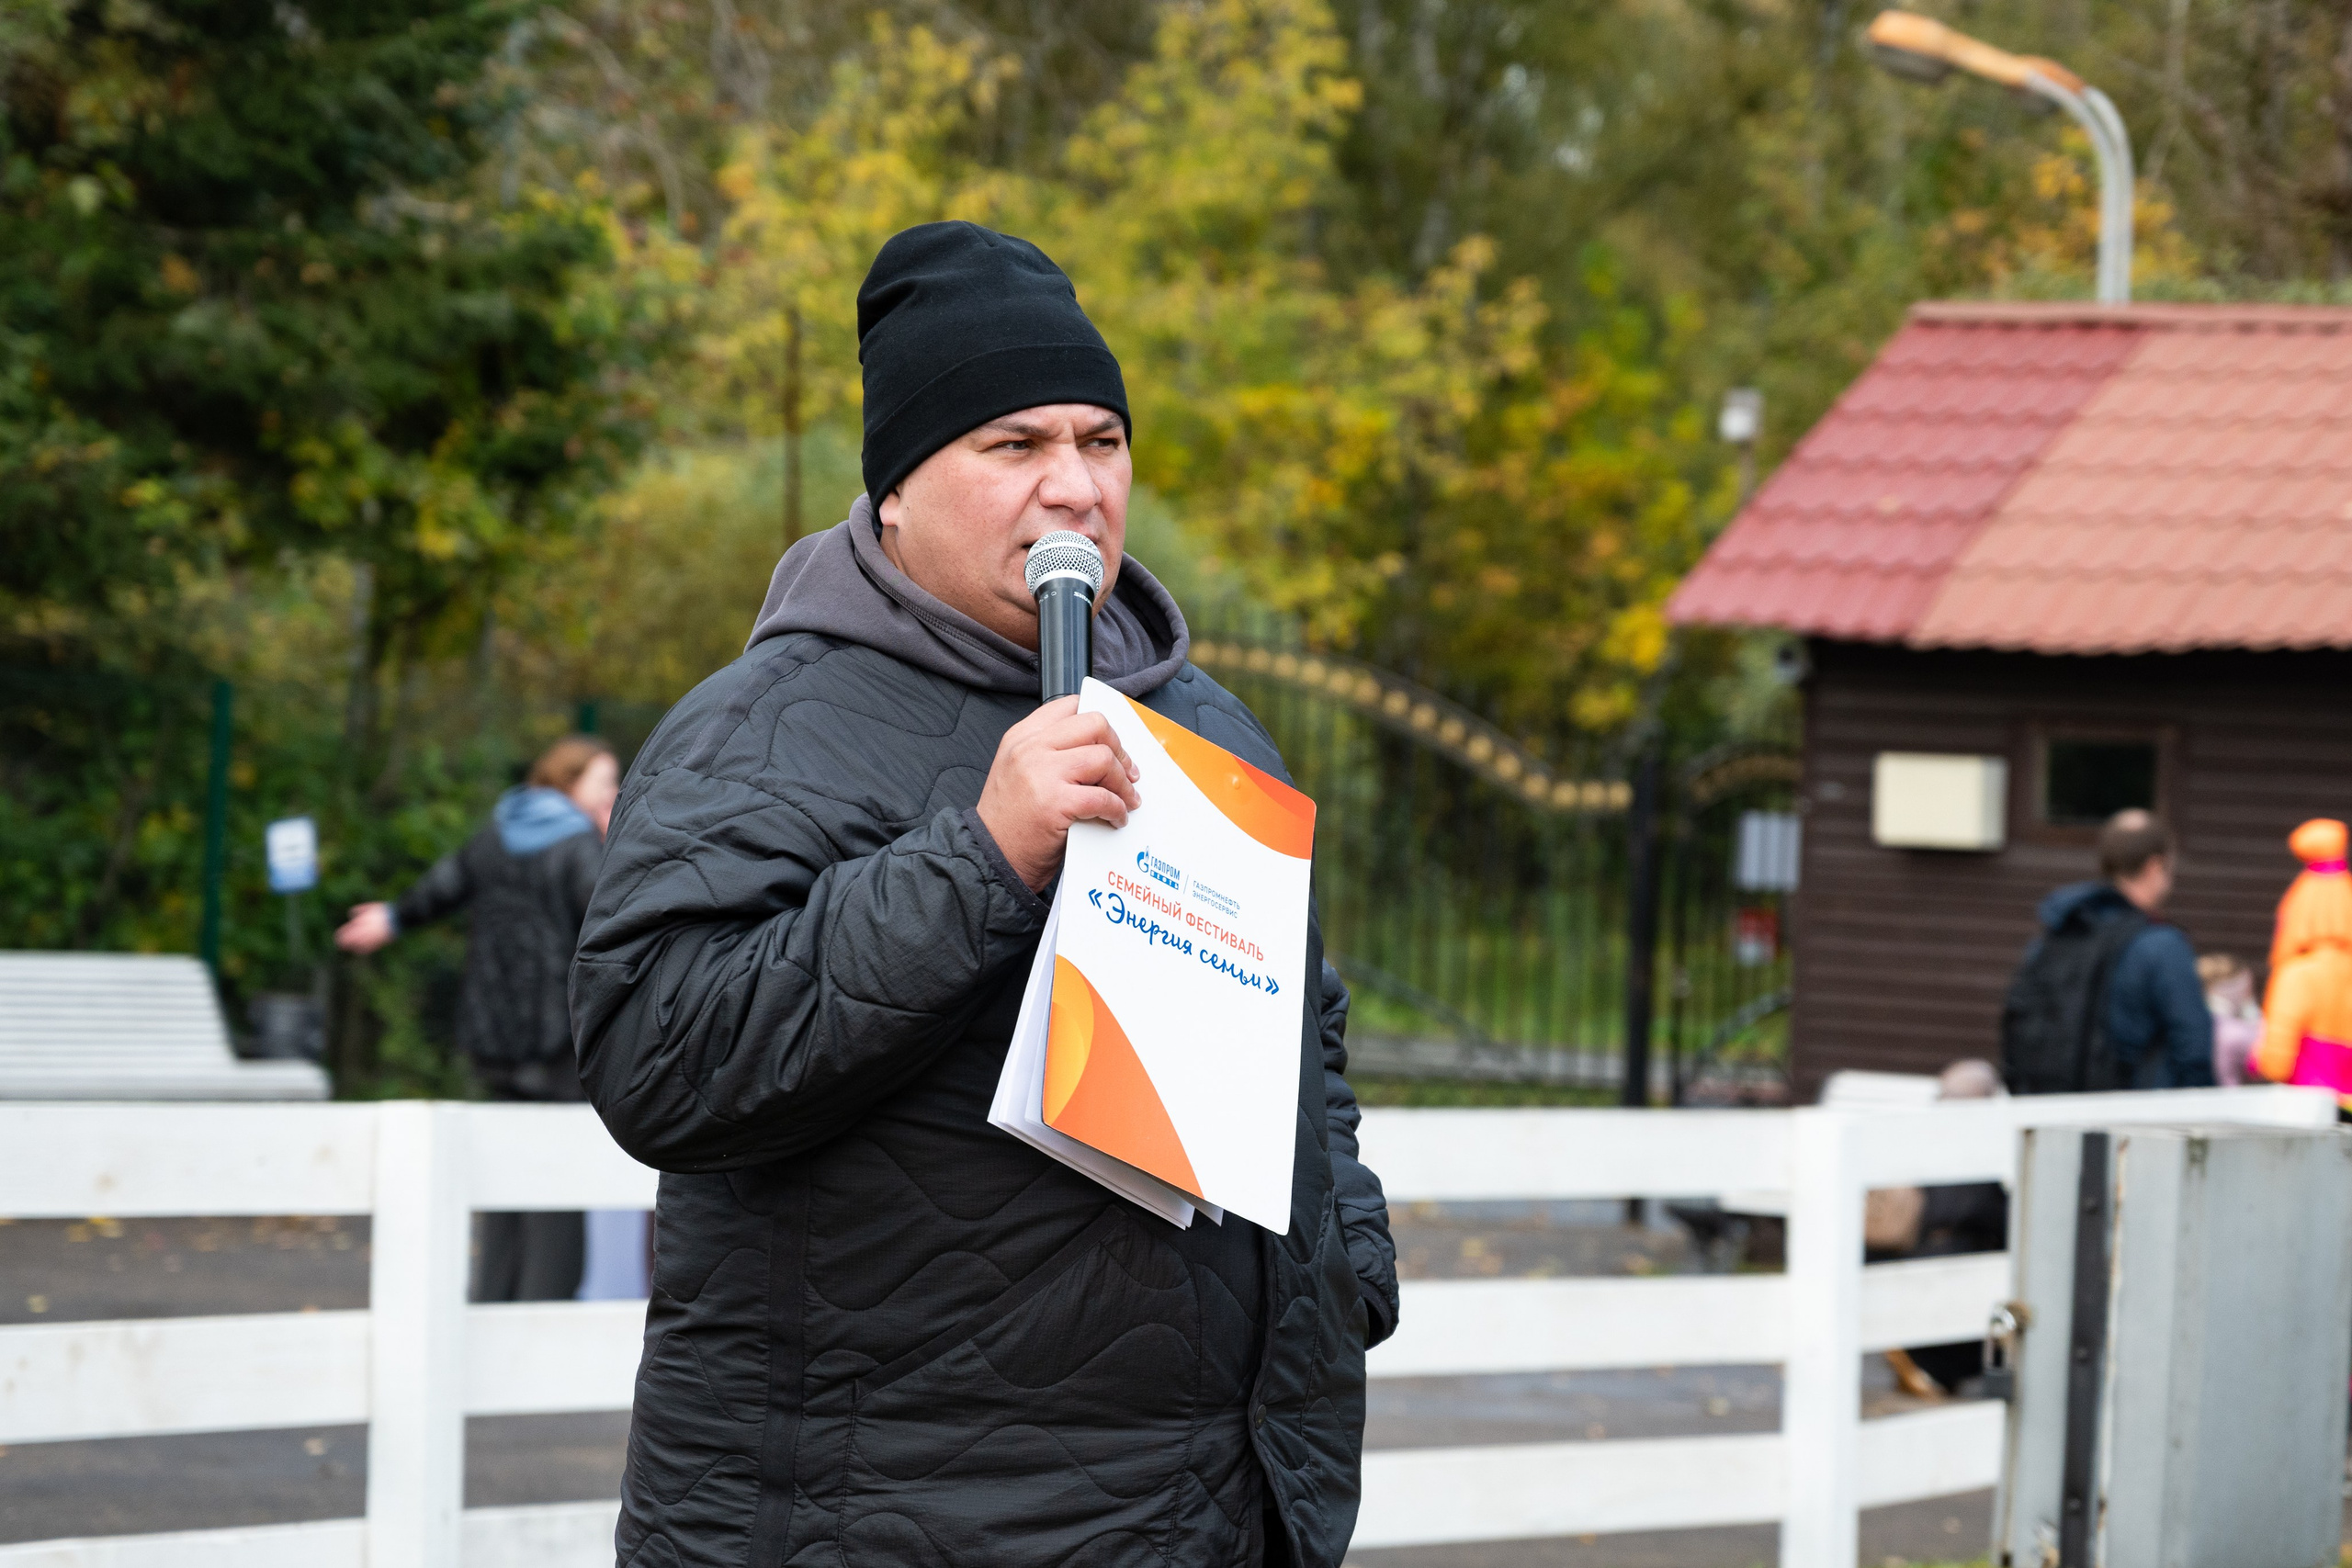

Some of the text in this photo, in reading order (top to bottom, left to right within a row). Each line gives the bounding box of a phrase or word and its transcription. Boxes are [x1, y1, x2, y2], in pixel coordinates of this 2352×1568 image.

[1150, 856, 1181, 881] ГАЗПРОМ
[1193, 880, 1241, 910] ГАЗПРОМНЕФТЬ
[1193, 890, 1238, 919] ЭНЕРГОСЕРВИС
[1088, 888, 1193, 955] «Энергия
[1107, 871, 1264, 962] СЕМЕЙНЫЙ ФЕСТИВАЛЬ
